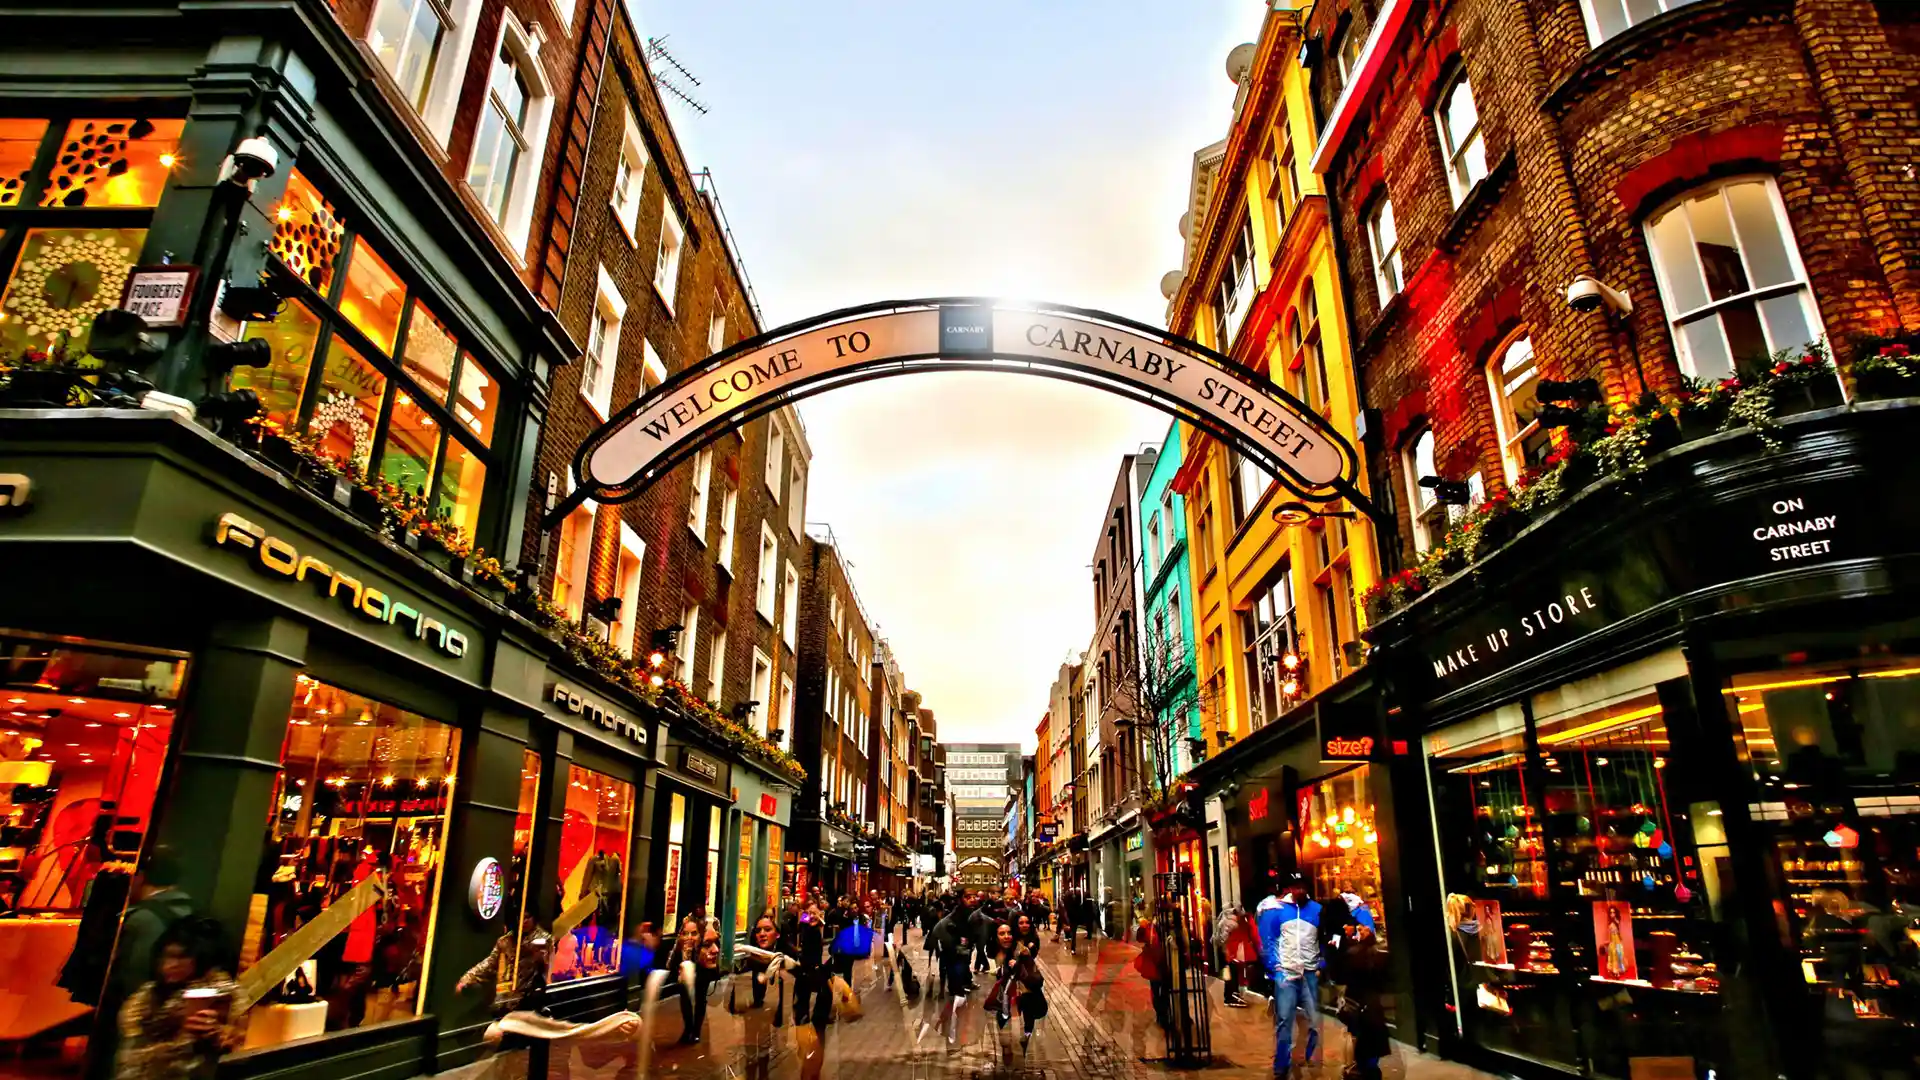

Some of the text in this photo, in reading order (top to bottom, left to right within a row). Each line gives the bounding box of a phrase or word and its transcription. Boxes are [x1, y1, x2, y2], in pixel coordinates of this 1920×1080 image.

[131, 282, 184, 299] FOUBERT'S
[131, 302, 163, 317] PLACE
[640, 324, 1314, 460] WELCOME TO CARNABY STREET
[1772, 498, 1804, 514] ON
[1753, 515, 1837, 541] CARNABY
[1770, 540, 1831, 561] STREET
[1433, 586, 1596, 678] MAKE UP STORE
[1327, 736, 1375, 756] size?
